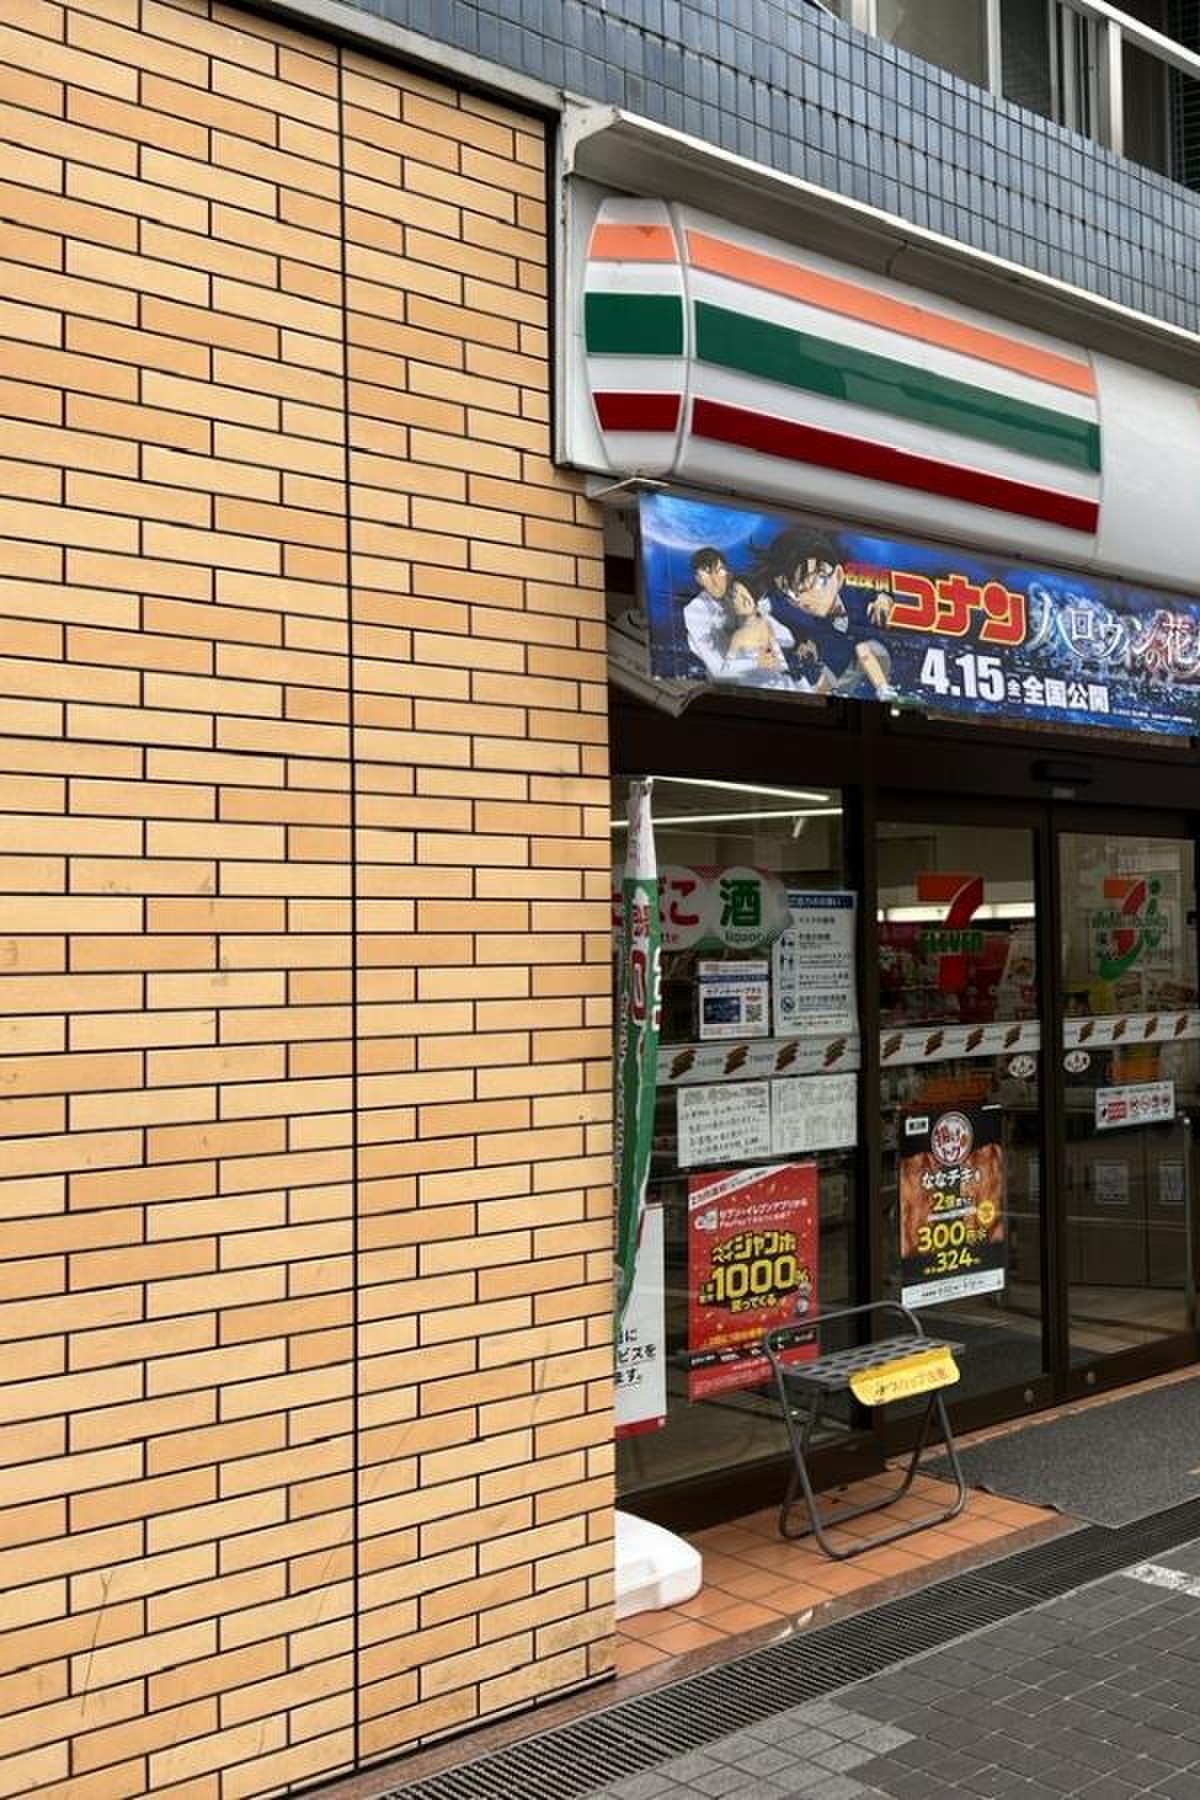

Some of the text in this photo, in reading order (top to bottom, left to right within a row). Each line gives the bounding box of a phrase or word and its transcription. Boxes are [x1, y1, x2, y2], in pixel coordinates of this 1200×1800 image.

[888, 571, 1026, 646] コナン
[720, 878, 762, 928] 酒
